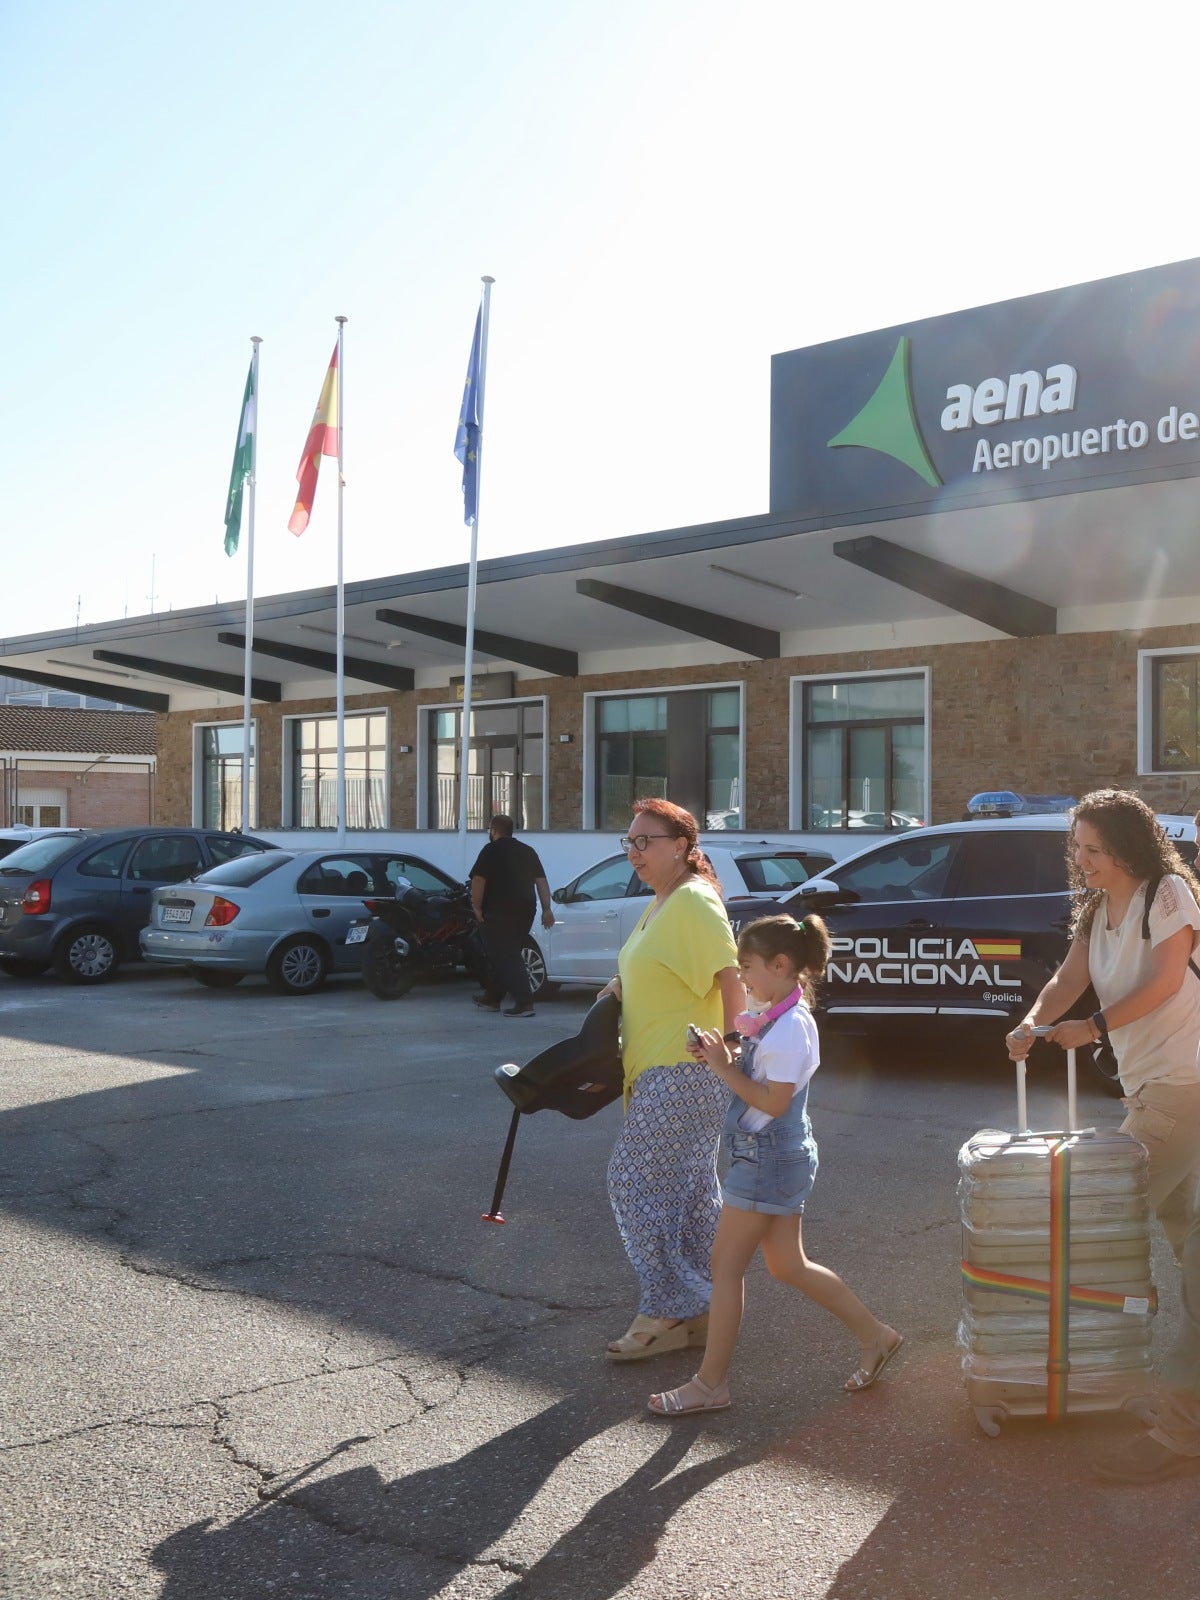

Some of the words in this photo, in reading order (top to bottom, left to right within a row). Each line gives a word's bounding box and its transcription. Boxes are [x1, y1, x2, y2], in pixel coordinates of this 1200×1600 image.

[940, 363, 1077, 432] aena
[972, 418, 1149, 473] Aeropuerto
[1157, 406, 1199, 443] de
[827, 962, 1022, 987] NACIONAL
[982, 991, 1023, 1003] @policia
